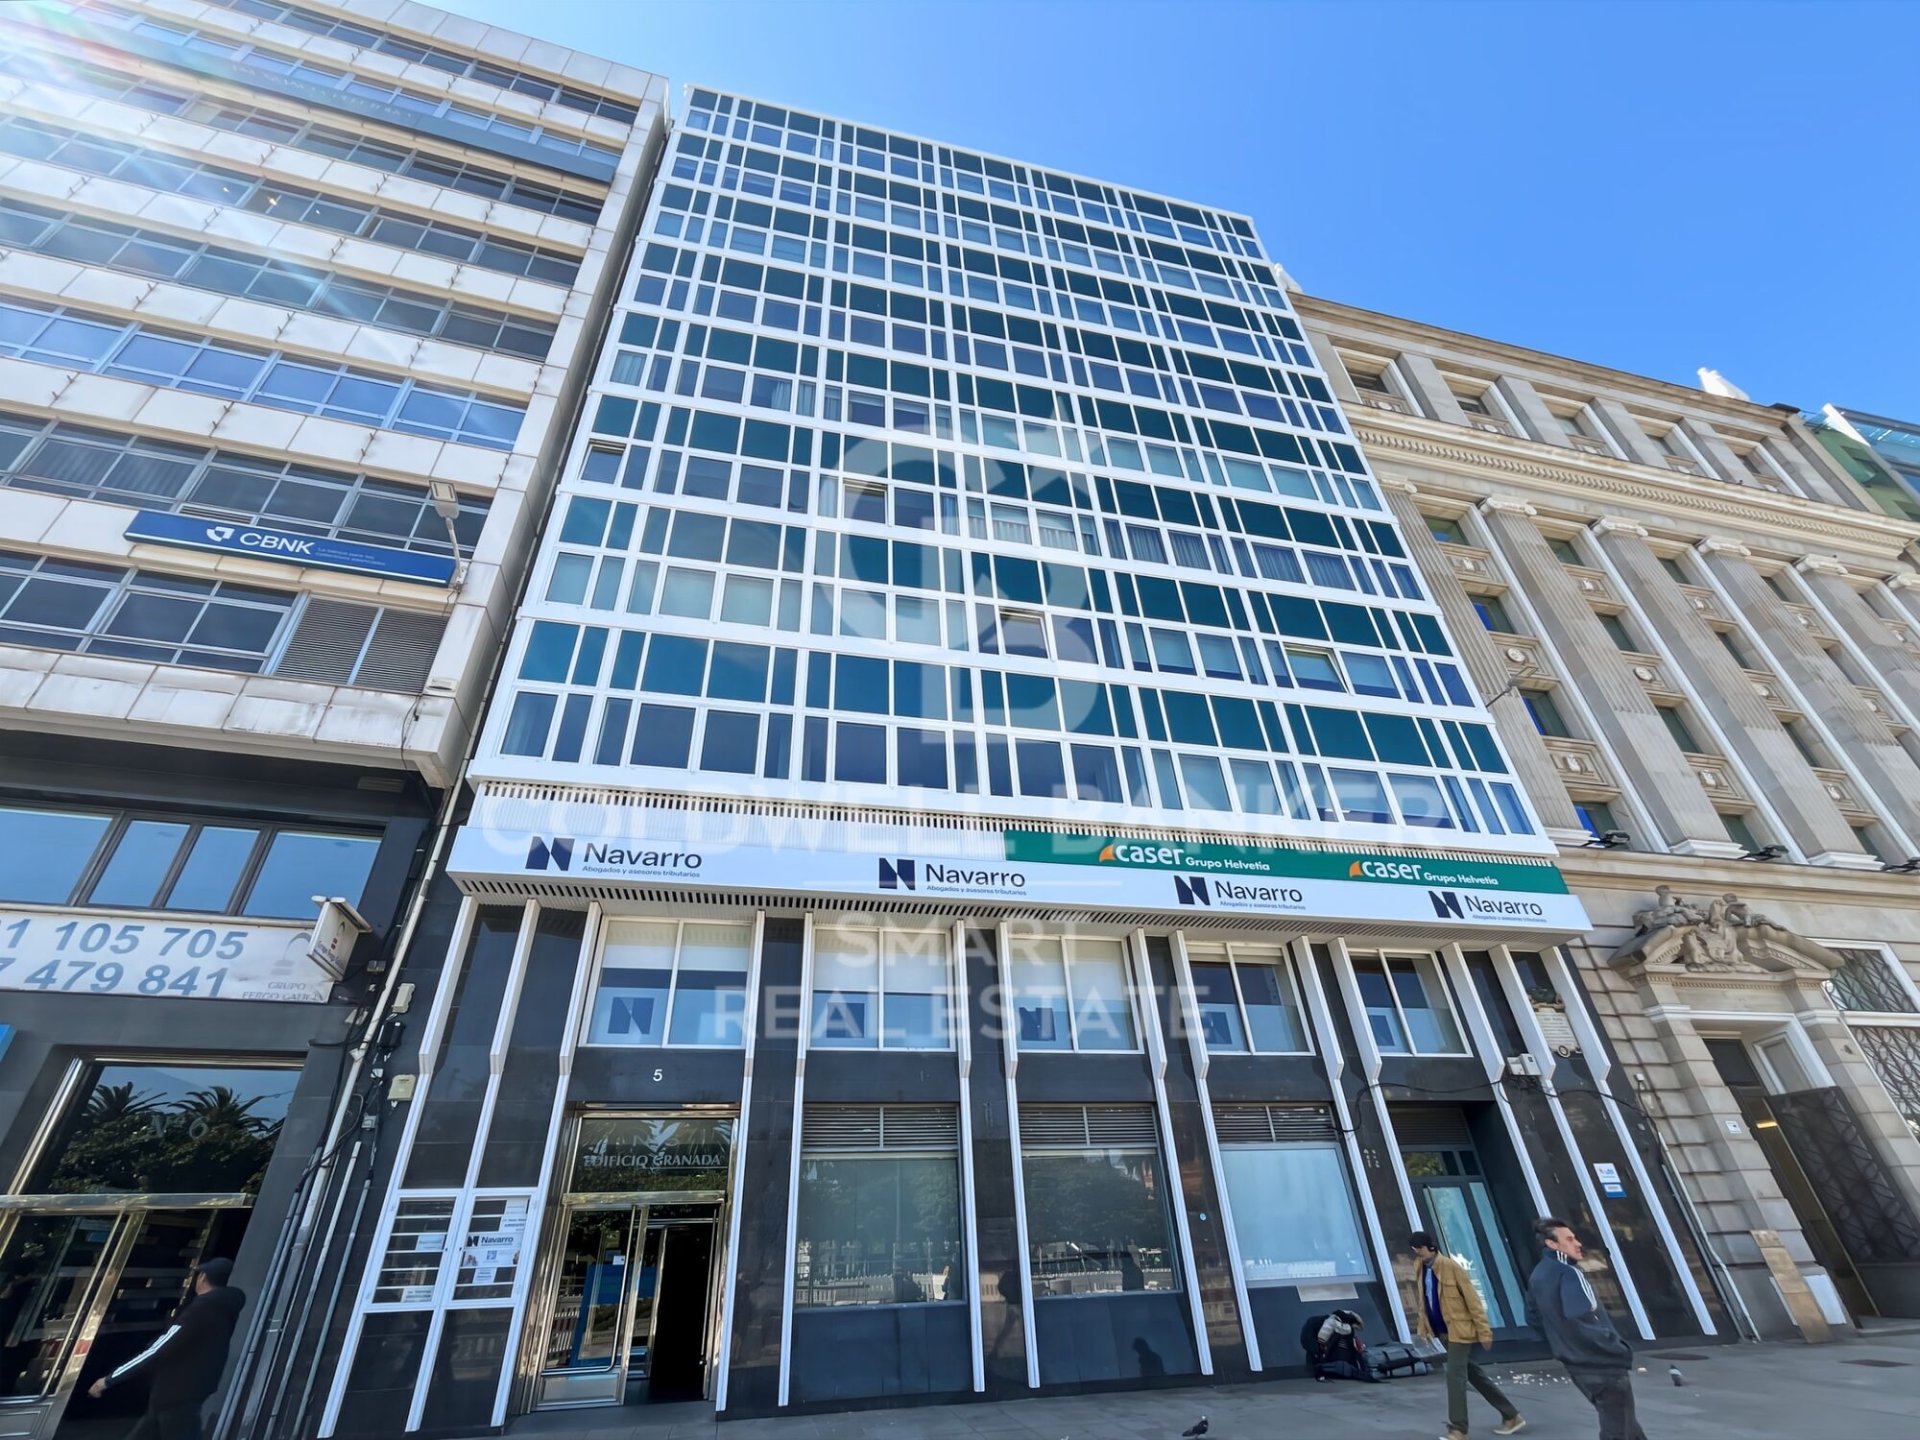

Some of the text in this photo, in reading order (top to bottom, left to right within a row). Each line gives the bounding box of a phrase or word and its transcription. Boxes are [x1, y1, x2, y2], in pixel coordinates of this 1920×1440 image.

[240, 532, 316, 555] CBNK
[583, 843, 702, 869] Navarro
[1115, 844, 1271, 871] caser Grupo Helvetia
[582, 865, 620, 874] Abogados
[628, 868, 662, 876] asesores
[662, 870, 701, 878] tributarios
[926, 864, 1026, 888] Navarro
[1361, 860, 1499, 885] caser Grupo Helvetia
[926, 885, 959, 893] Abogados
[994, 889, 1027, 897] tributarios
[1215, 880, 1303, 903] Navarro
[1465, 895, 1543, 916] Navarro
[0, 918, 249, 960] 1 105 705
[24, 959, 124, 993] 479
[138, 964, 229, 998] 841
[652, 1068, 664, 1082] 5
[583, 1154, 721, 1168] EDIFICIO GRANADA
